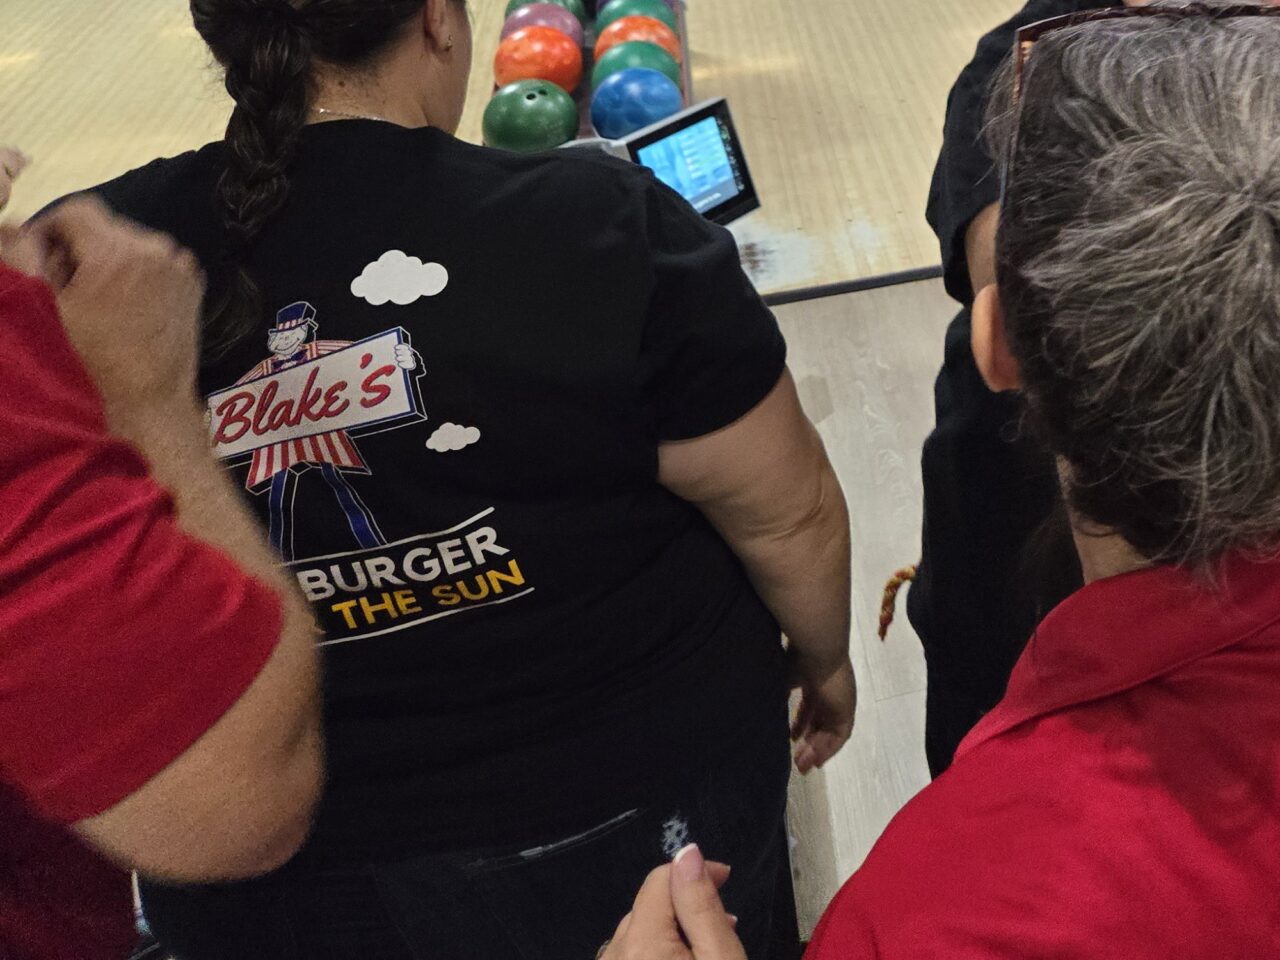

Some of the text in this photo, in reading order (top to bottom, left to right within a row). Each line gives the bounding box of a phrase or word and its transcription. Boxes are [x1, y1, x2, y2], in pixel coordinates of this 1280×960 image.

[213, 352, 396, 445] Blake's
[296, 526, 510, 602] BURGER
[332, 558, 526, 630] THE SUN
